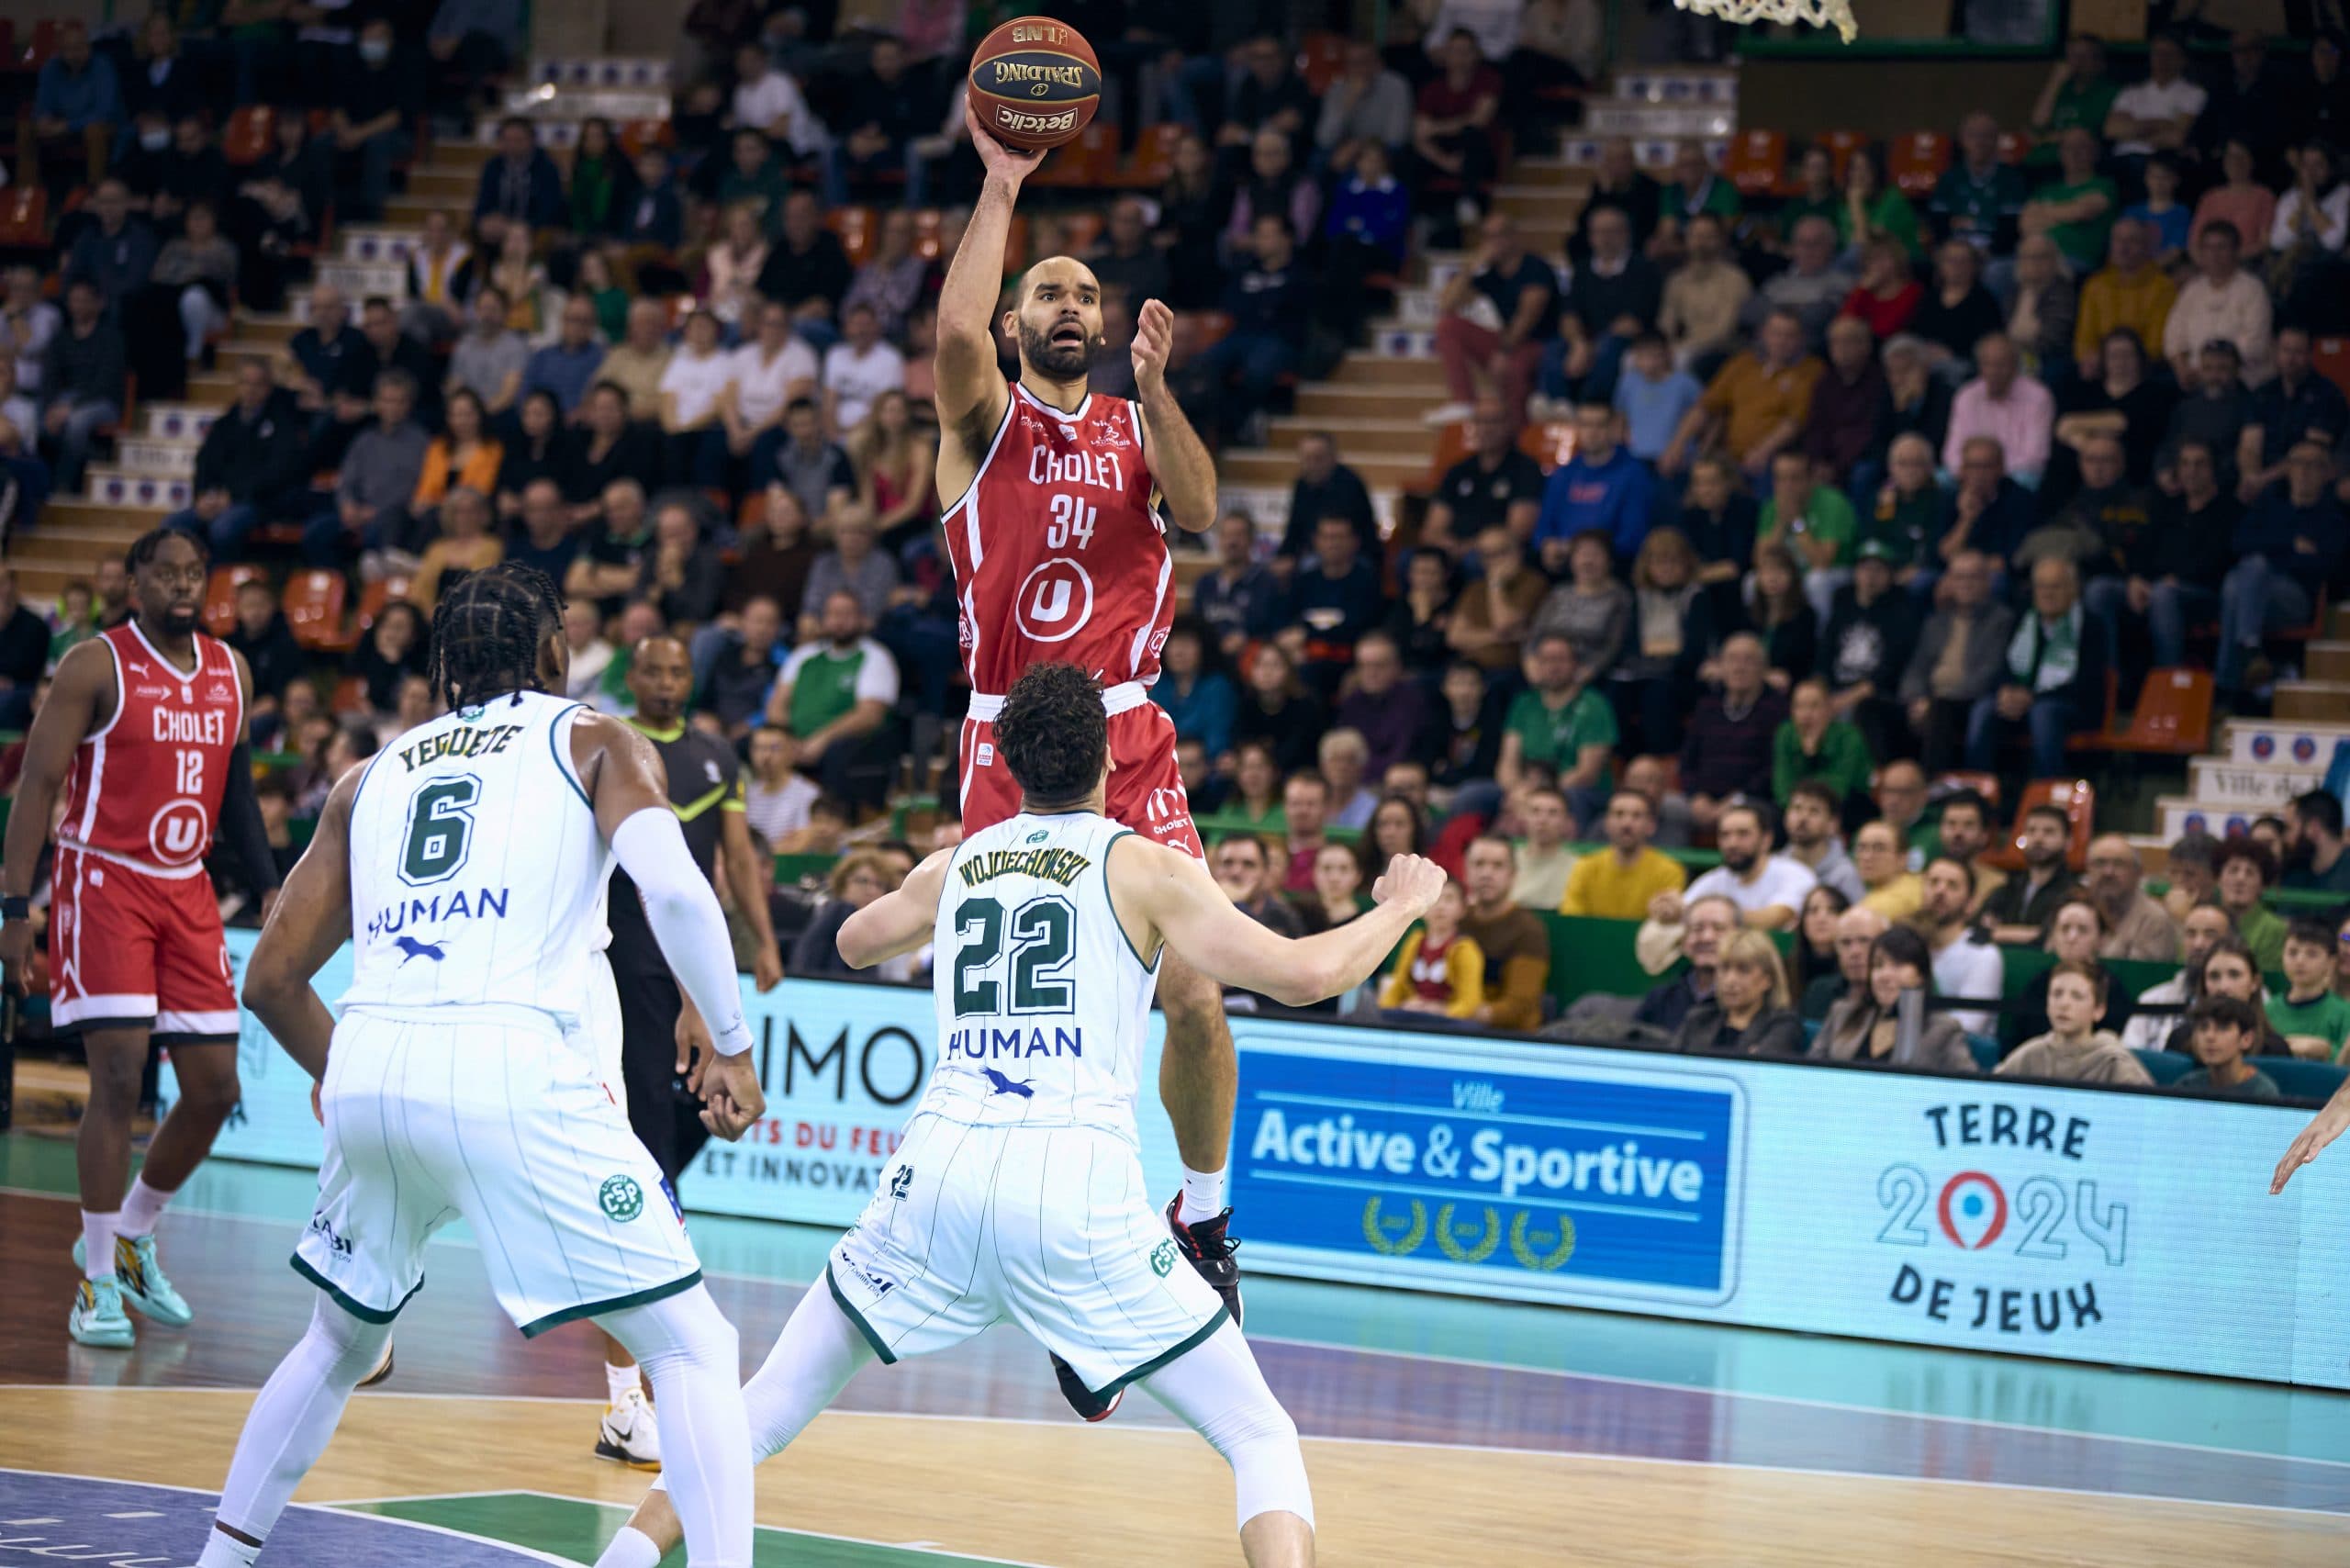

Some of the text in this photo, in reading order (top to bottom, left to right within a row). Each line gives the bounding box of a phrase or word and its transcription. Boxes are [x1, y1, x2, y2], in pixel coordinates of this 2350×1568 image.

[1013, 26, 1055, 42] LNB
[1000, 110, 1075, 132] Betclic
[1029, 444, 1123, 491] CHOLET
[1047, 494, 1097, 550] 34
[153, 706, 226, 745] CHOLET
[176, 749, 203, 795] 12
[397, 773, 483, 888] 6
[1153, 818, 1189, 834] CHOLET
[958, 848, 1091, 889] WOJCIECHOWSKI
[367, 889, 509, 945] HUMAN
[953, 894, 1077, 1020] 22
[947, 1027, 1082, 1060] HUMAN
[1452, 1081, 1505, 1113] Ville
[746, 1118, 783, 1145] TS
[796, 1123, 837, 1149] DU
[1924, 1103, 2091, 1160] TERRE
[705, 1150, 738, 1176] ET
[1251, 1108, 1703, 1202] Active & Sportive
[603, 1182, 638, 1213] CSP
[890, 1164, 914, 1202] 22
[1876, 1161, 2129, 1267] 2024
[1890, 1263, 2102, 1333] DE JEUX
